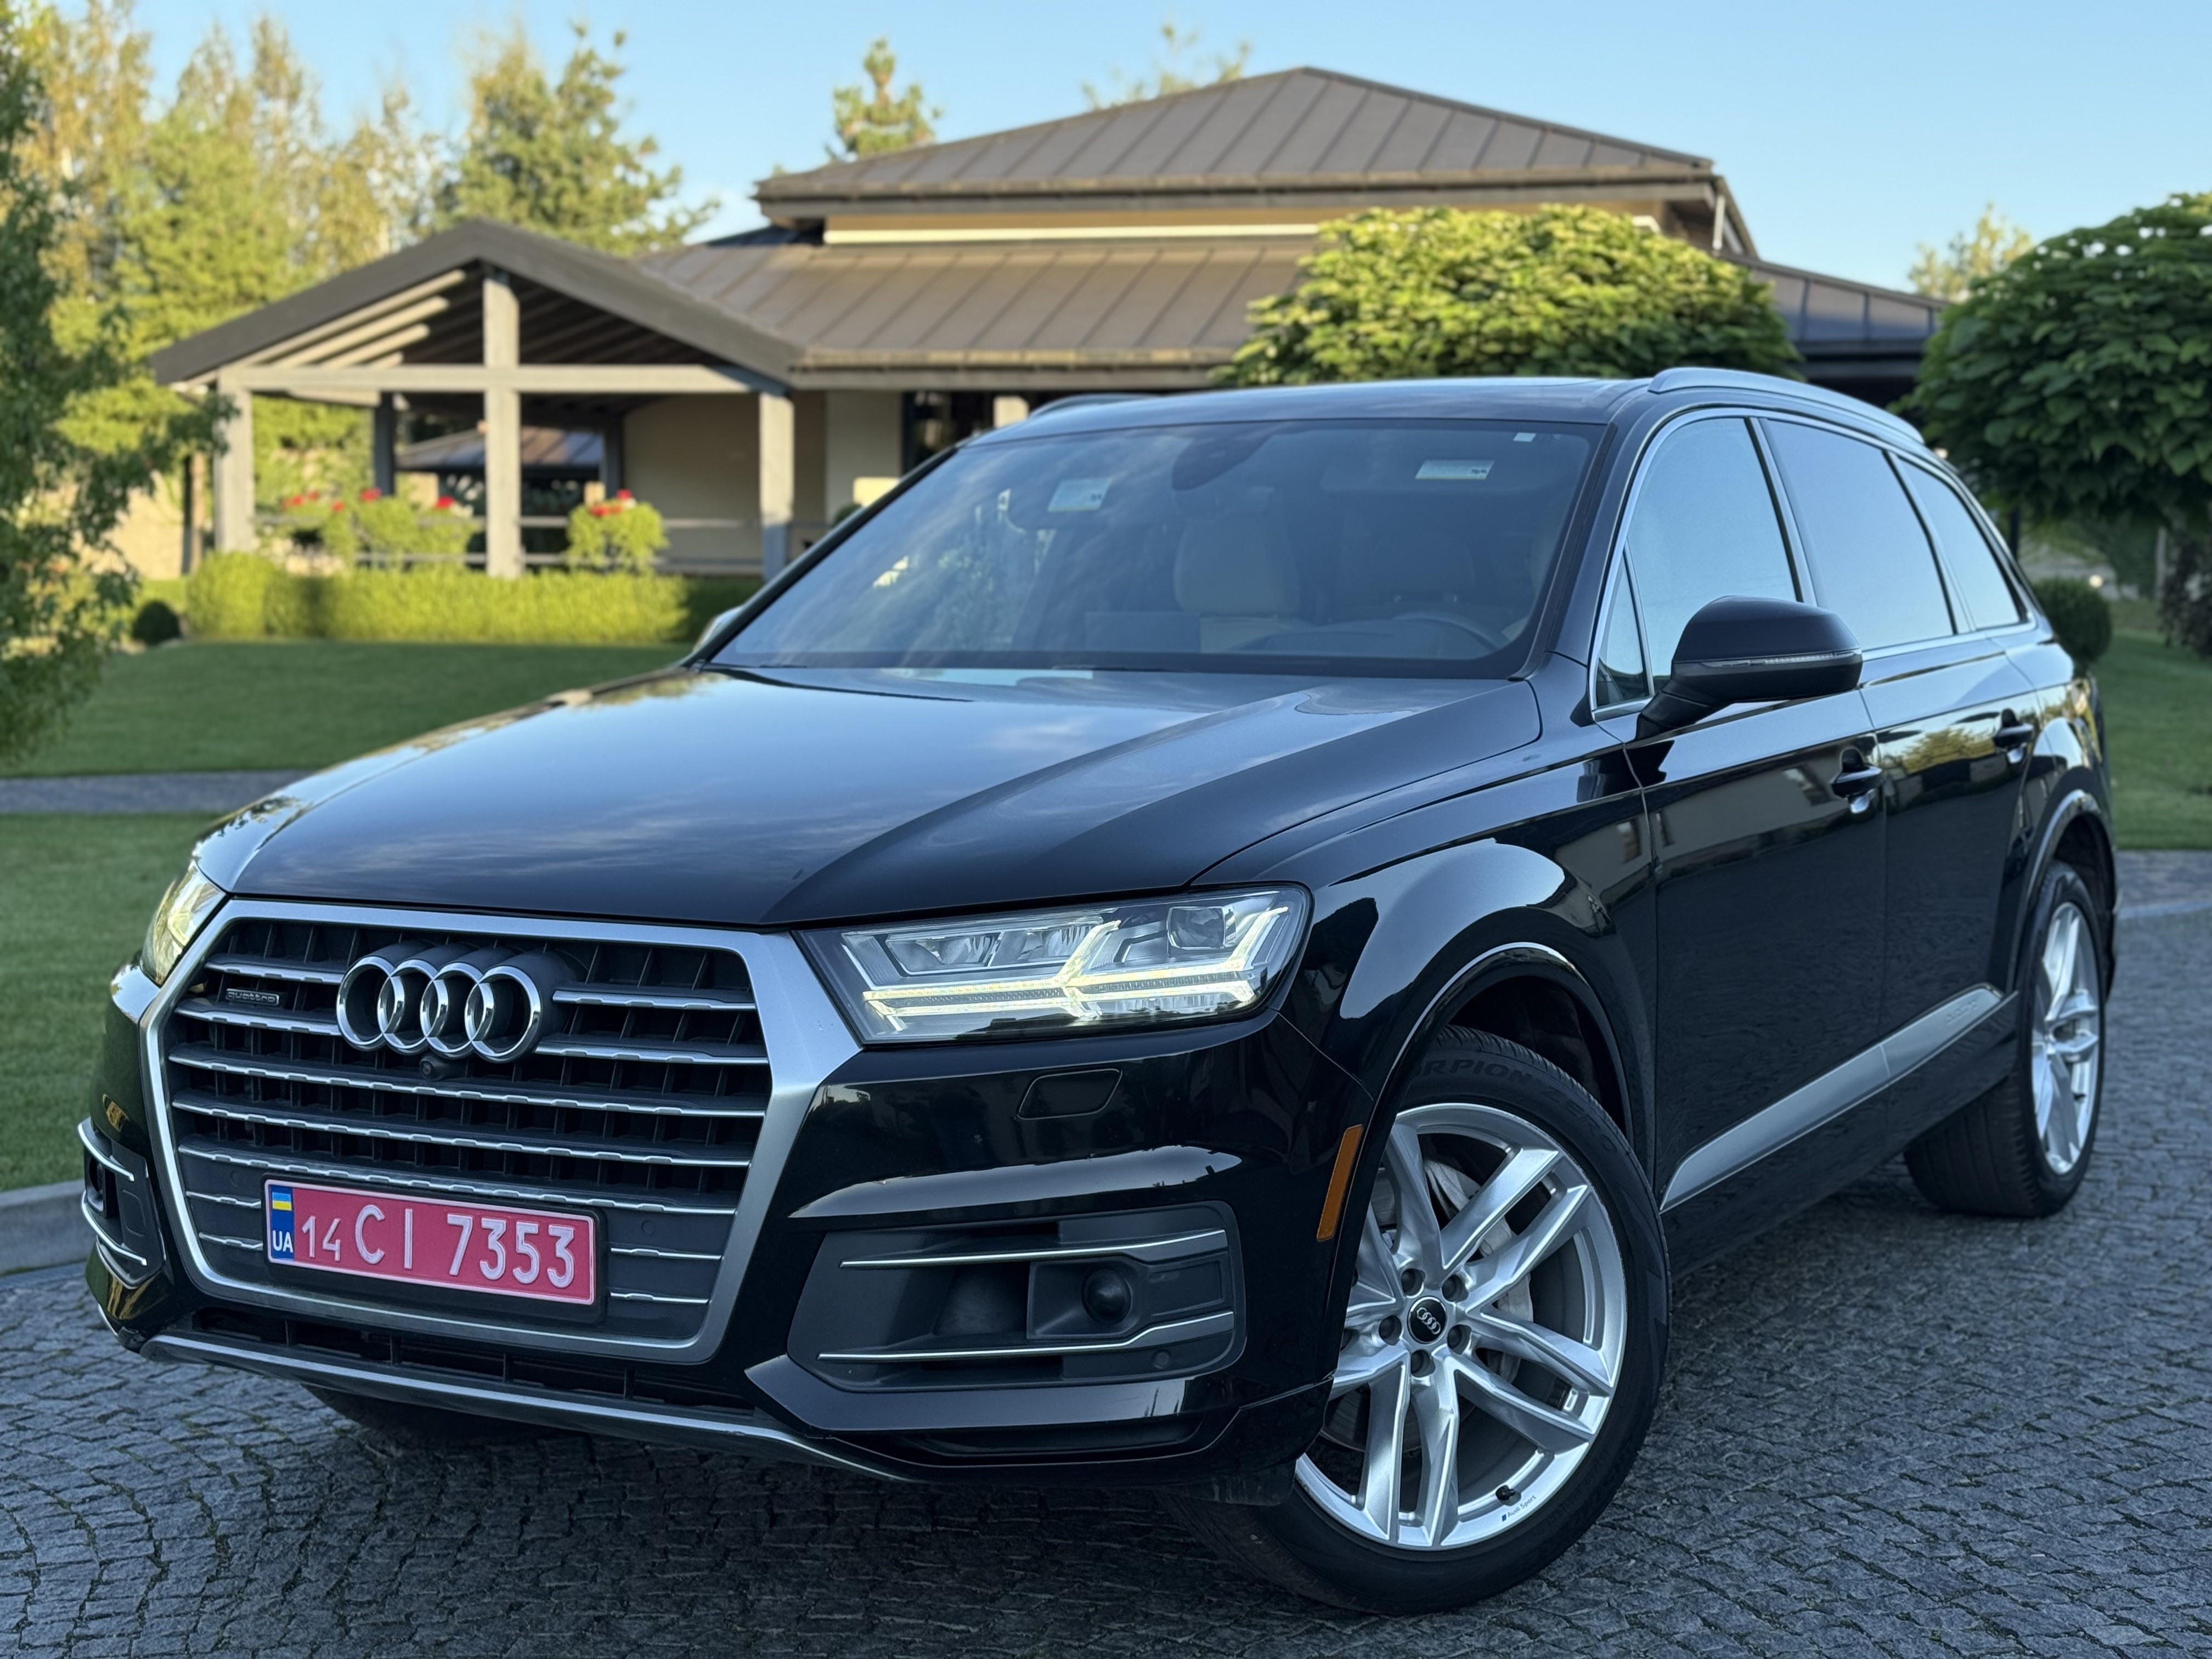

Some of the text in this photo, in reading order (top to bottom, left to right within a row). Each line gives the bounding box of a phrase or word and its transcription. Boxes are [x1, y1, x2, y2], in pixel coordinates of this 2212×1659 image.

[228, 991, 275, 1003] quattro
[1414, 1059, 1533, 1086] RPION
[272, 1229, 294, 1253] UA
[302, 1215, 341, 1262] 14
[447, 1214, 575, 1289] 7353
[1507, 1495, 1537, 1518] Audi Sport
